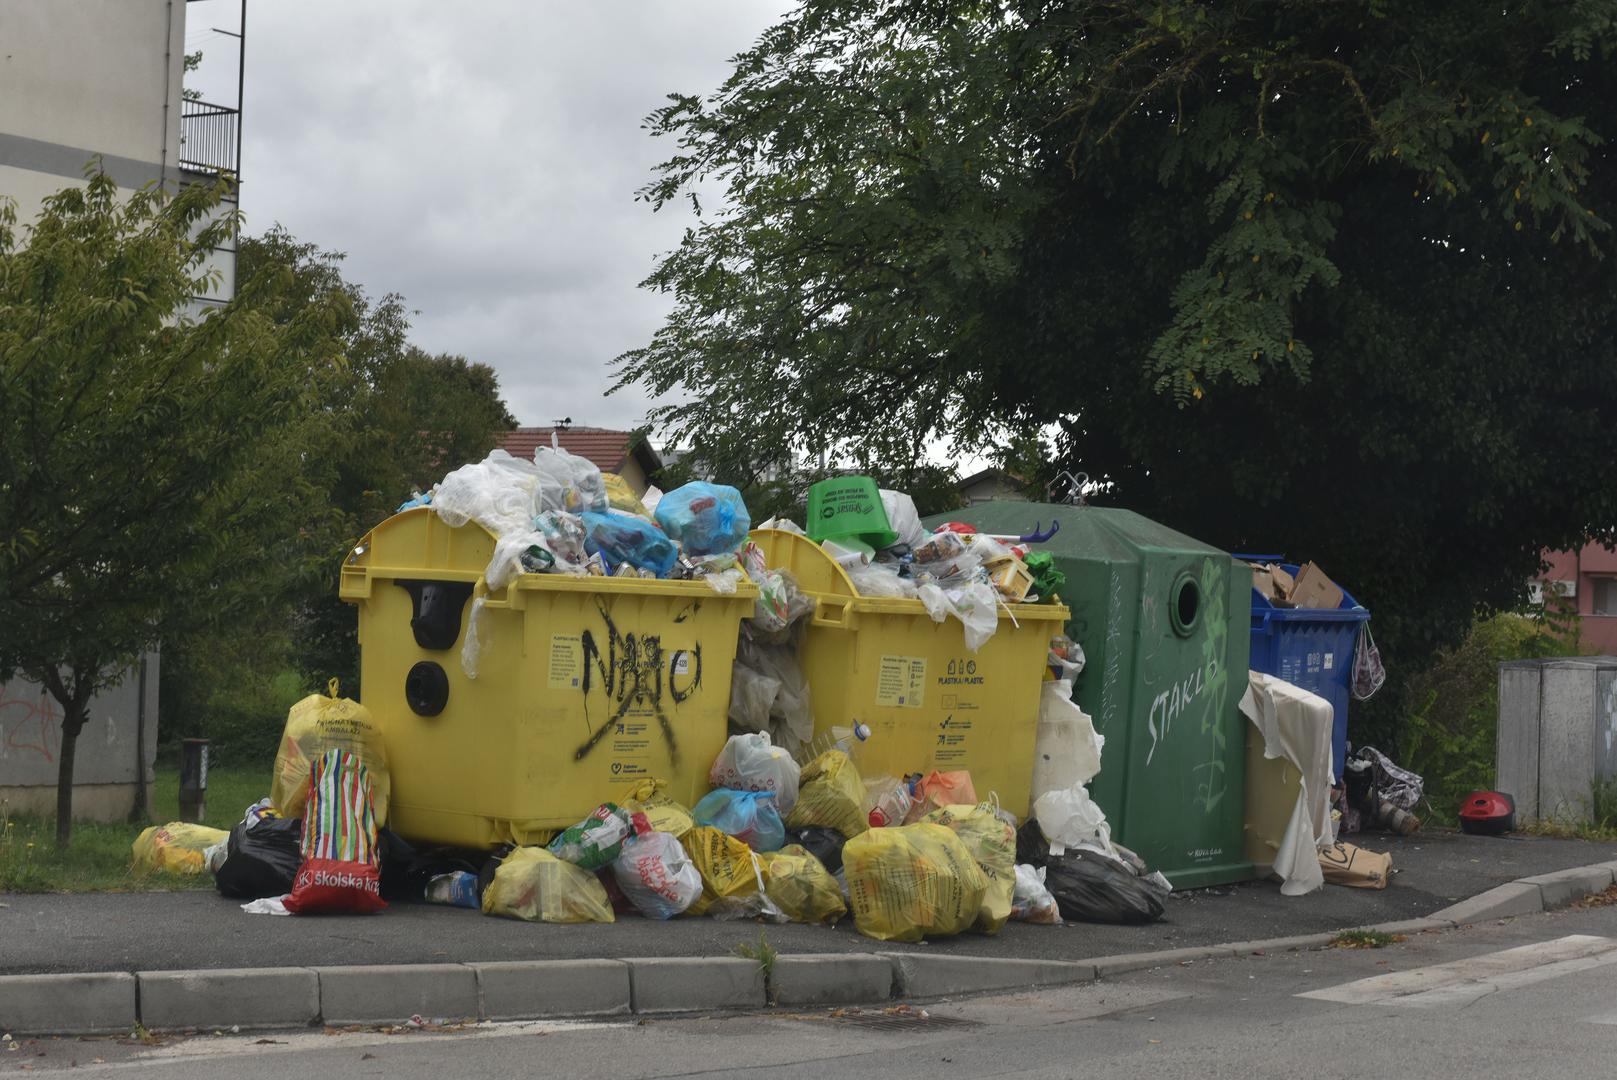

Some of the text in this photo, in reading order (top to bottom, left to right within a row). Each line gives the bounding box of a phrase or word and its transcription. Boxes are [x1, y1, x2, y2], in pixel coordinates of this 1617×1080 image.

[938, 677, 962, 685] PLASTIKA
[965, 677, 984, 685] PLASTIC
[314, 870, 363, 891] školska
